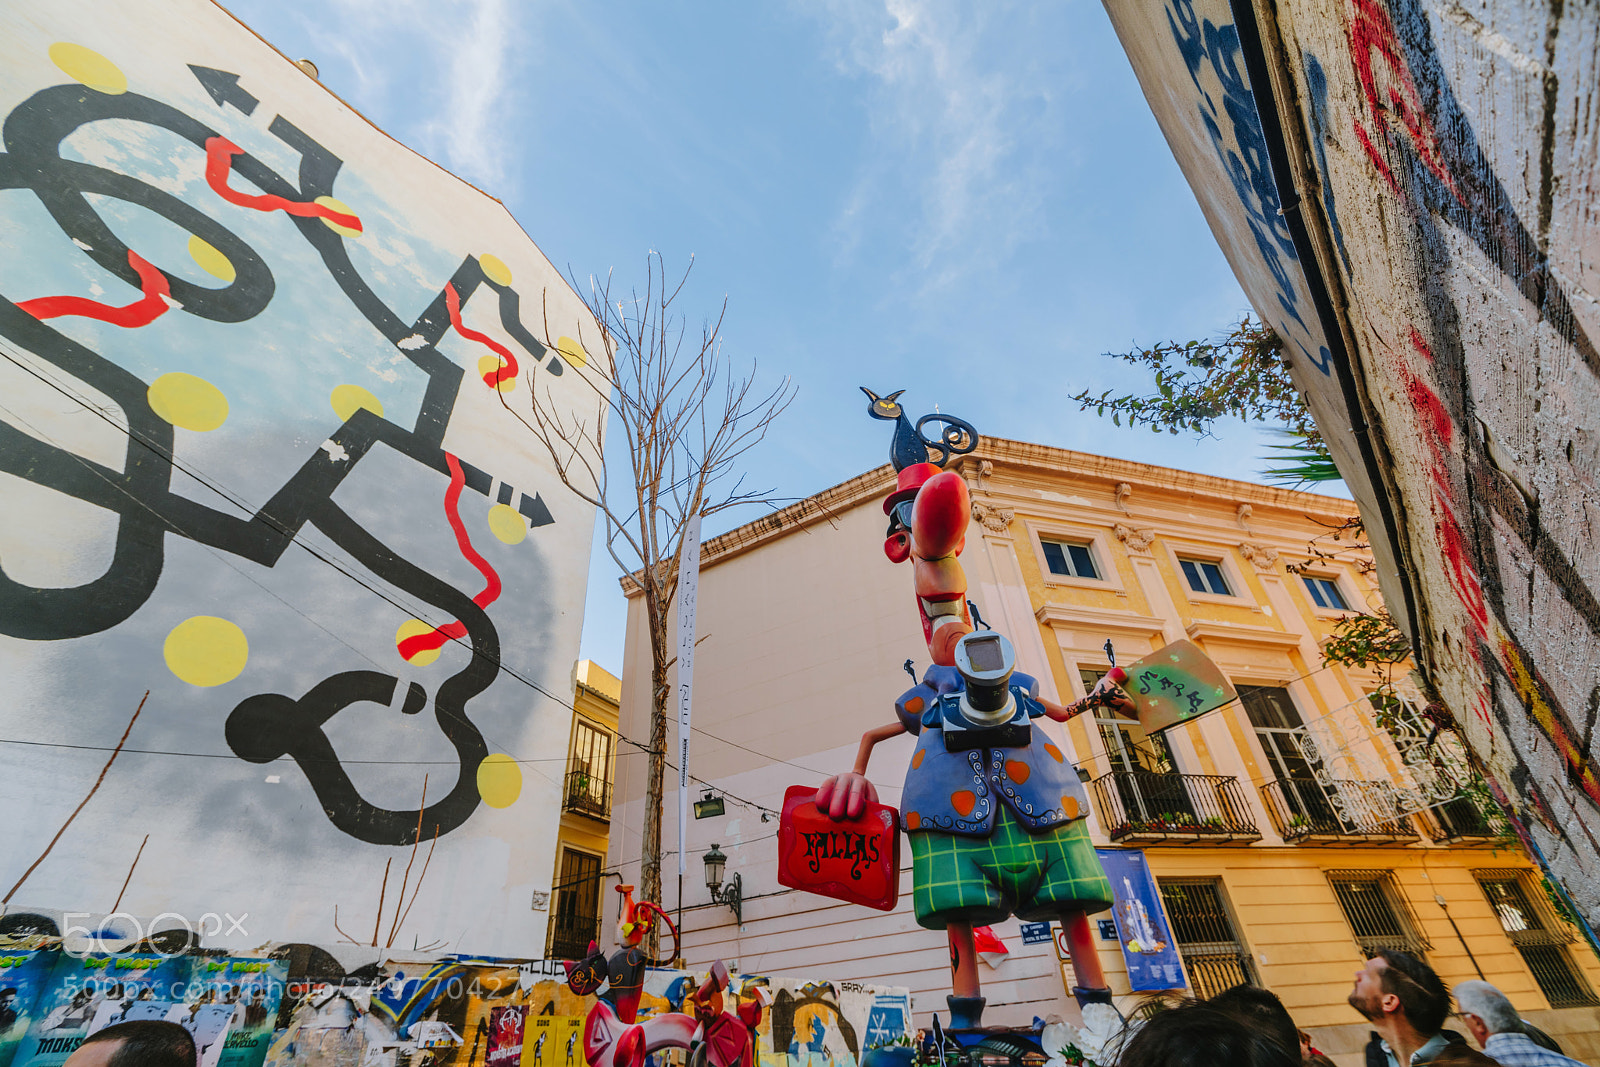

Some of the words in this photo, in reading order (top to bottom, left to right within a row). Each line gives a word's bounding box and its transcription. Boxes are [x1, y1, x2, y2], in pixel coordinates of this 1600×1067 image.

[1140, 671, 1204, 713] MAPA
[799, 831, 881, 880] FALLAS
[223, 1039, 259, 1049] ERVELLO
